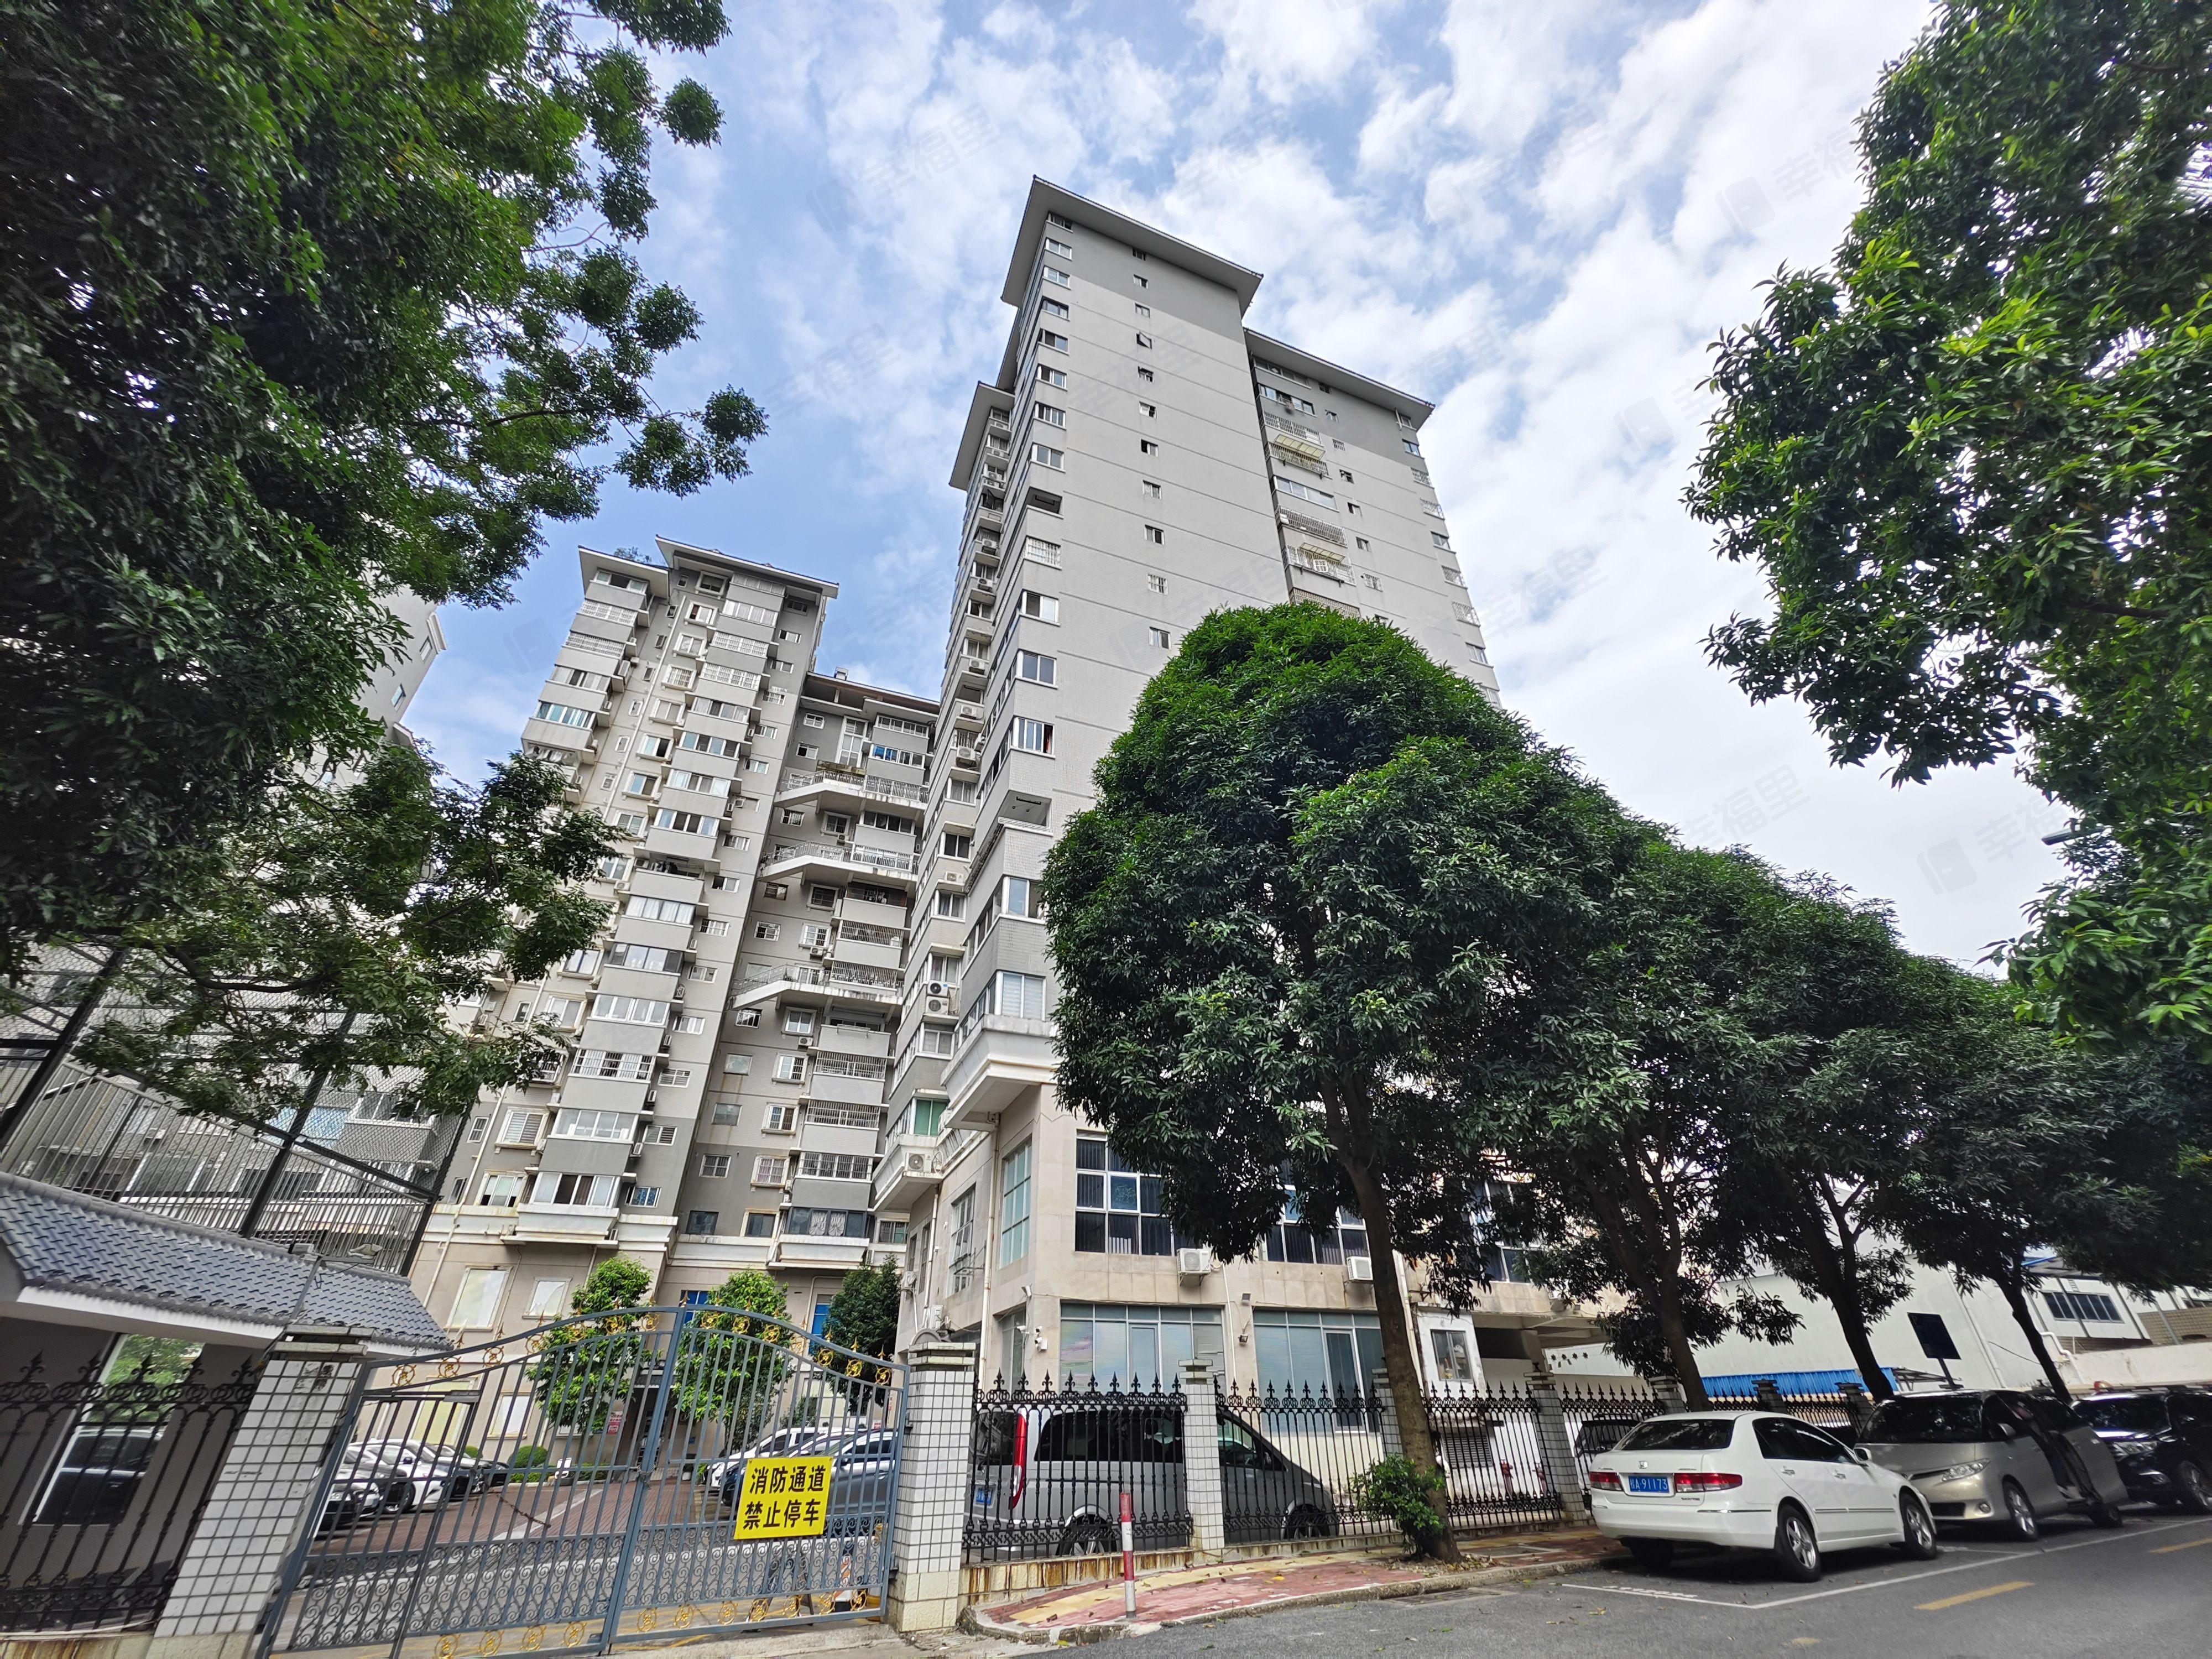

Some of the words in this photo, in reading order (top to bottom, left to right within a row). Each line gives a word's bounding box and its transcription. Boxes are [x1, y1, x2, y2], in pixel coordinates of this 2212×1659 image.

[749, 1465, 826, 1495] 消防通道
[743, 1498, 821, 1530] 禁止停车
